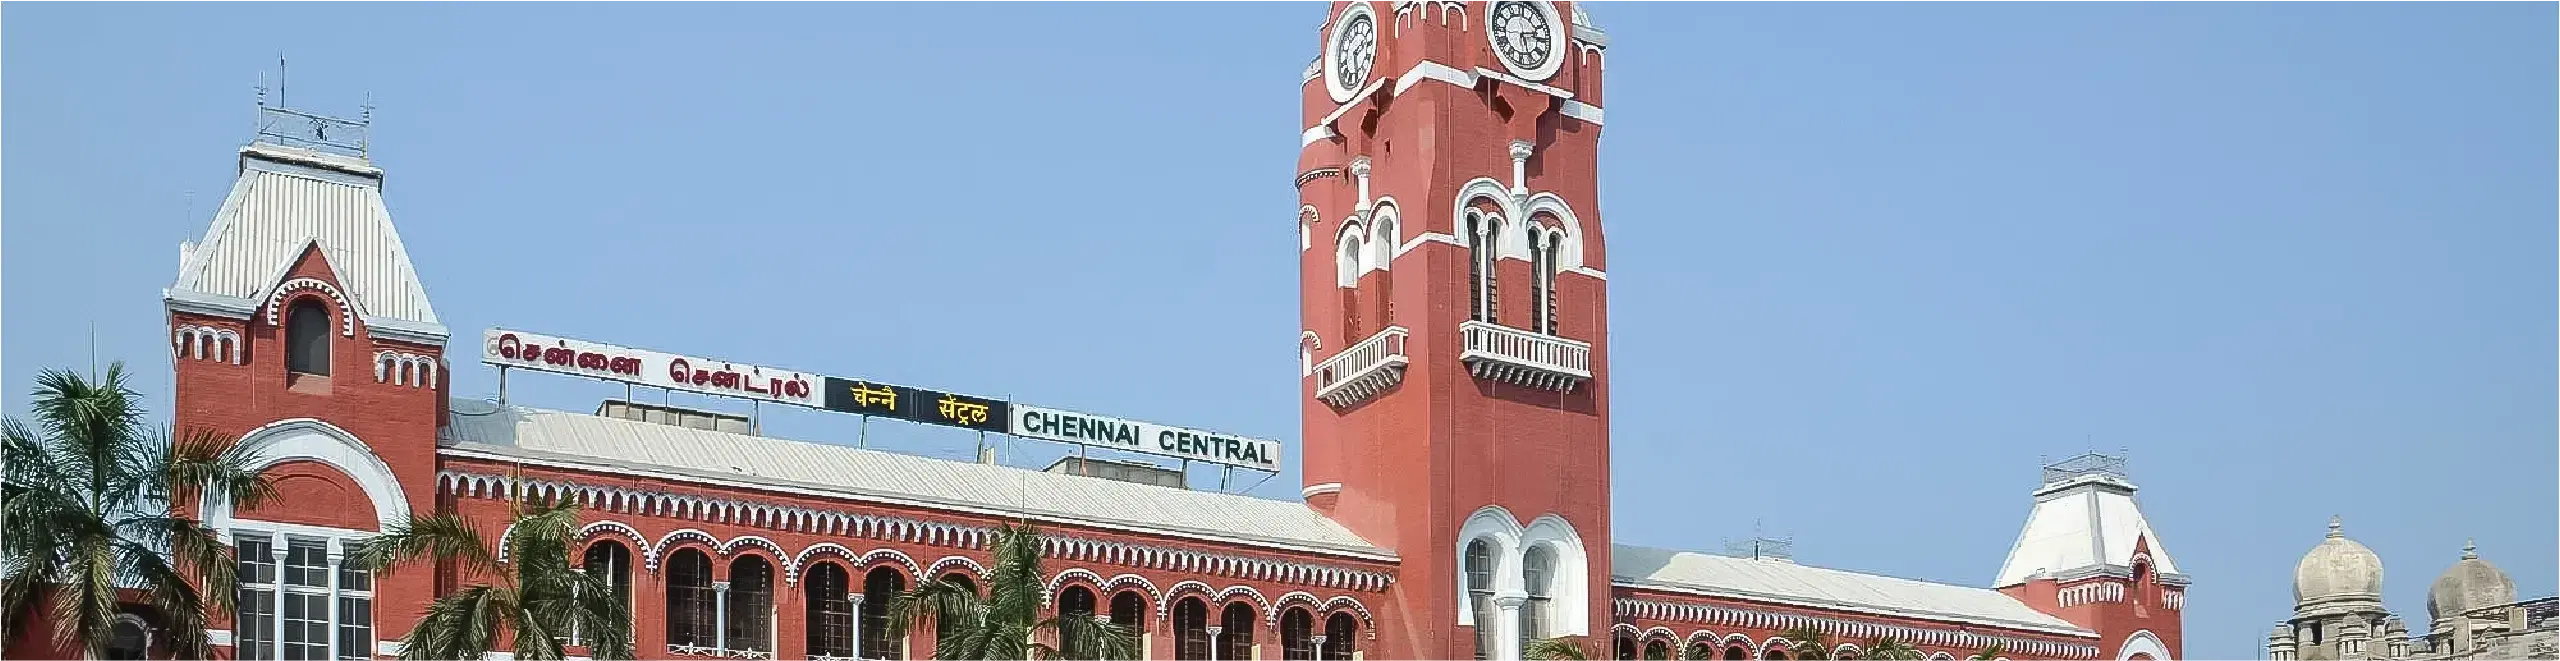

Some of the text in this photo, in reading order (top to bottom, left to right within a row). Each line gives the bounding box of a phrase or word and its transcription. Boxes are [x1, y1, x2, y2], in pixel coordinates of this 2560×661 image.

[499, 334, 810, 398] சென்னை சென்ட்ரல்
[1023, 411, 1273, 465] CHENNAI CENTRAL
